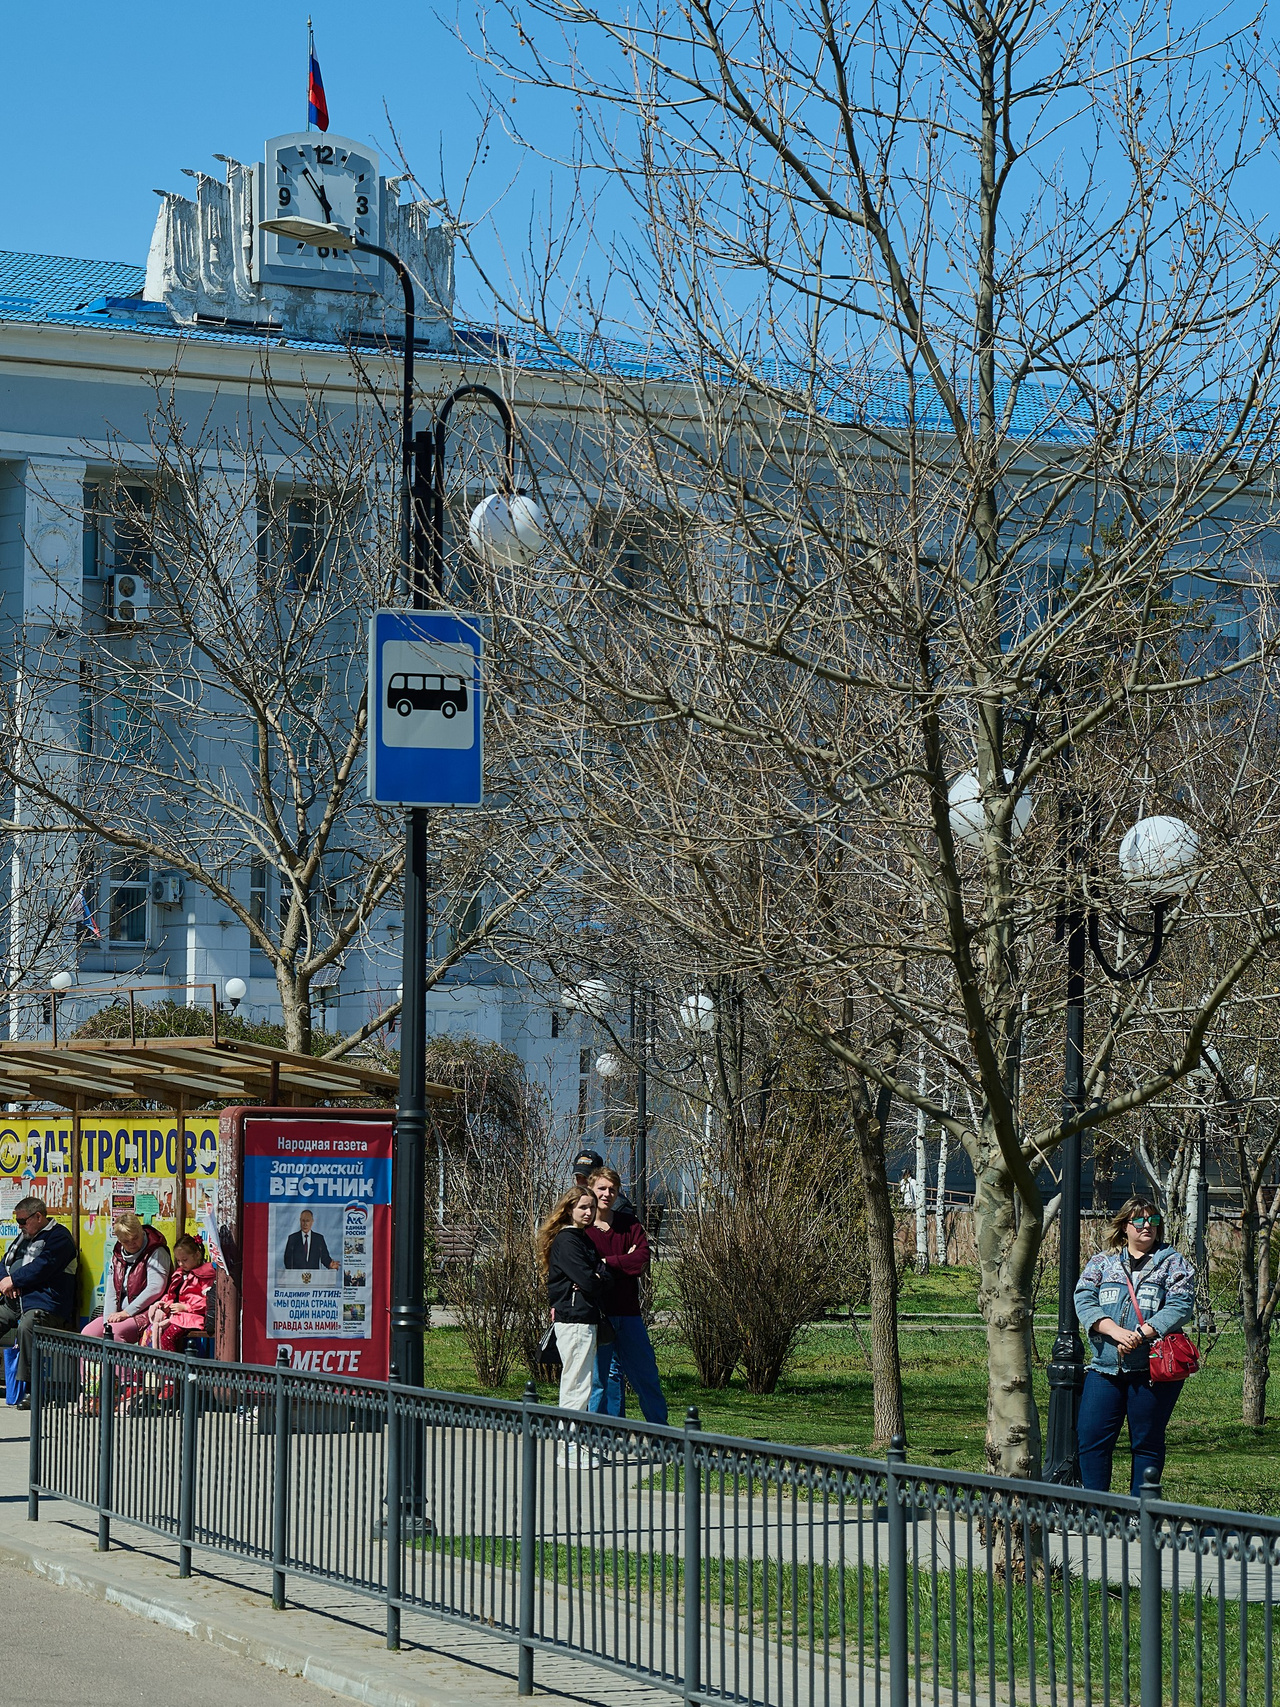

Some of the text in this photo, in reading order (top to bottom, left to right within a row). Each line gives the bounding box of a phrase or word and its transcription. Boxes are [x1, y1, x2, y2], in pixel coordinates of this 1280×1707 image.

[312, 145, 333, 165] 12
[278, 187, 291, 206] 9
[356, 196, 369, 215] 3
[277, 1136, 368, 1152] Народная газета
[270, 1160, 364, 1177] Запорожский
[270, 1176, 374, 1197] ВЕСТНИК
[312, 1290, 342, 1298] ПУТИН:
[273, 1299, 338, 1309] «МЫ ОДНА СТРАНА,
[289, 1310, 339, 1320] ОДИН НАРОД!
[273, 1321, 342, 1331] ПРАВДА ЗА НАМИ!»
